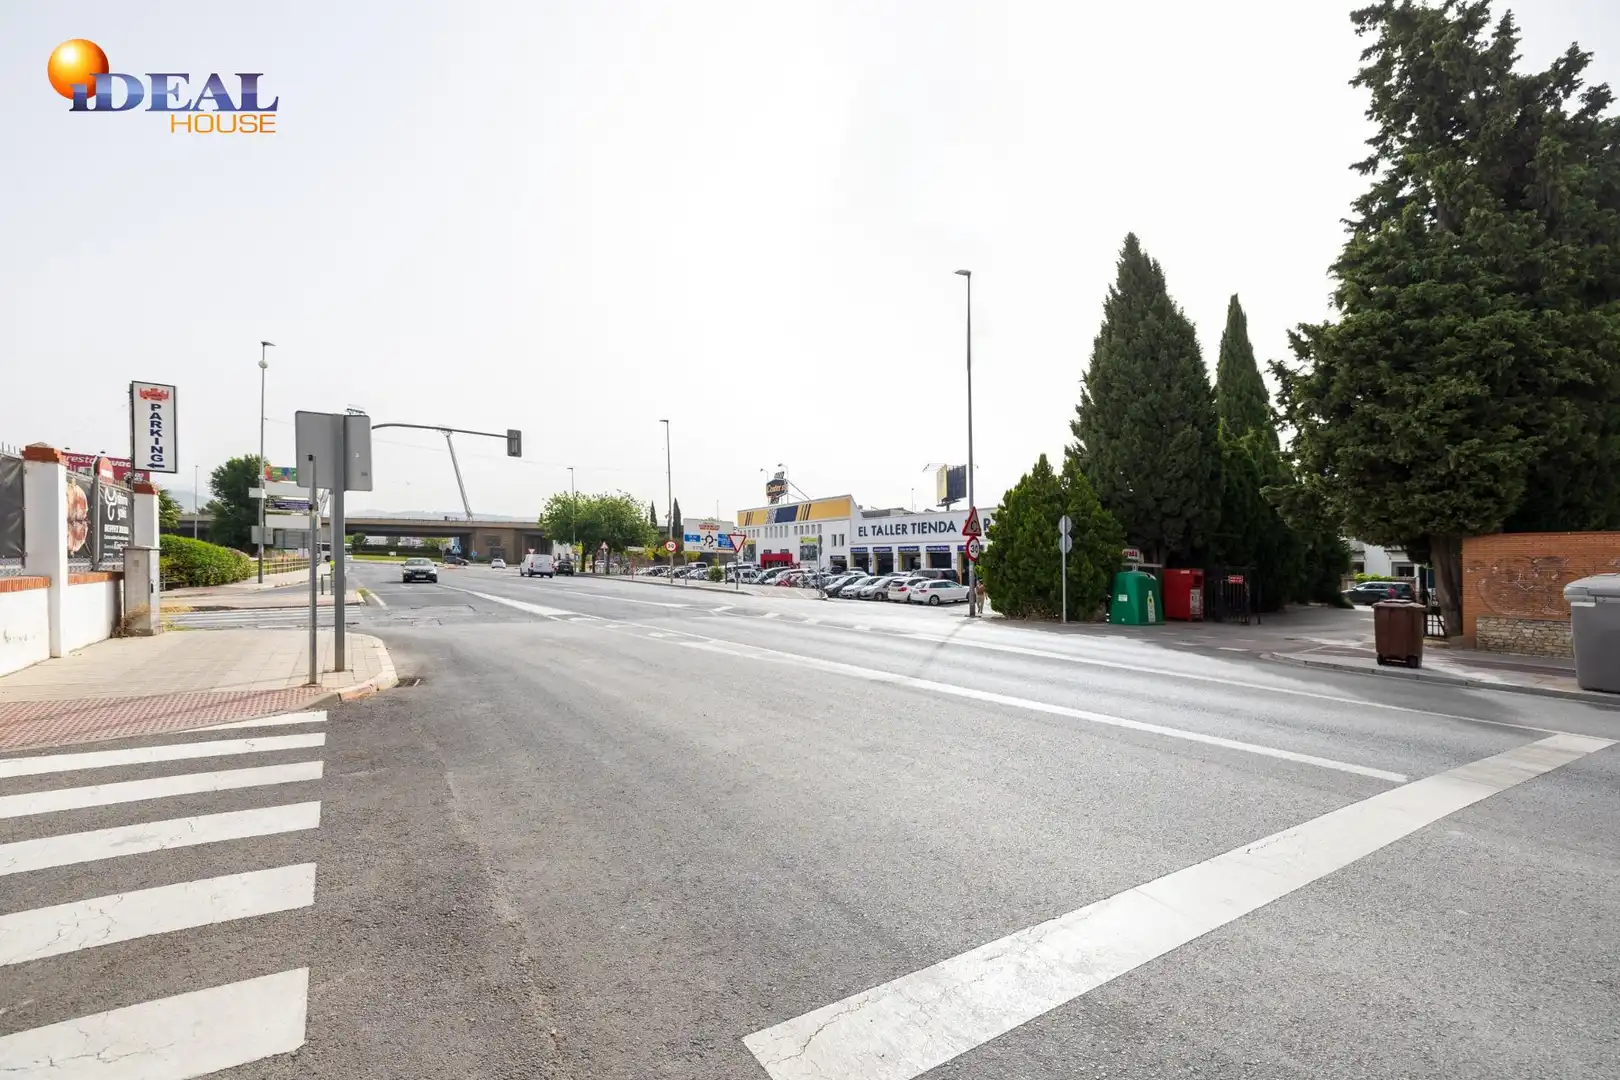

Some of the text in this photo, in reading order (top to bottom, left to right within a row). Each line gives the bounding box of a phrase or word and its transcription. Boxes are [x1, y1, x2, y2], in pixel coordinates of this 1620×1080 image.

[149, 403, 163, 462] PARKING
[858, 527, 868, 537] EL
[871, 523, 908, 537] TALLER
[911, 520, 957, 535] TIENDA
[970, 544, 978, 553] 30
